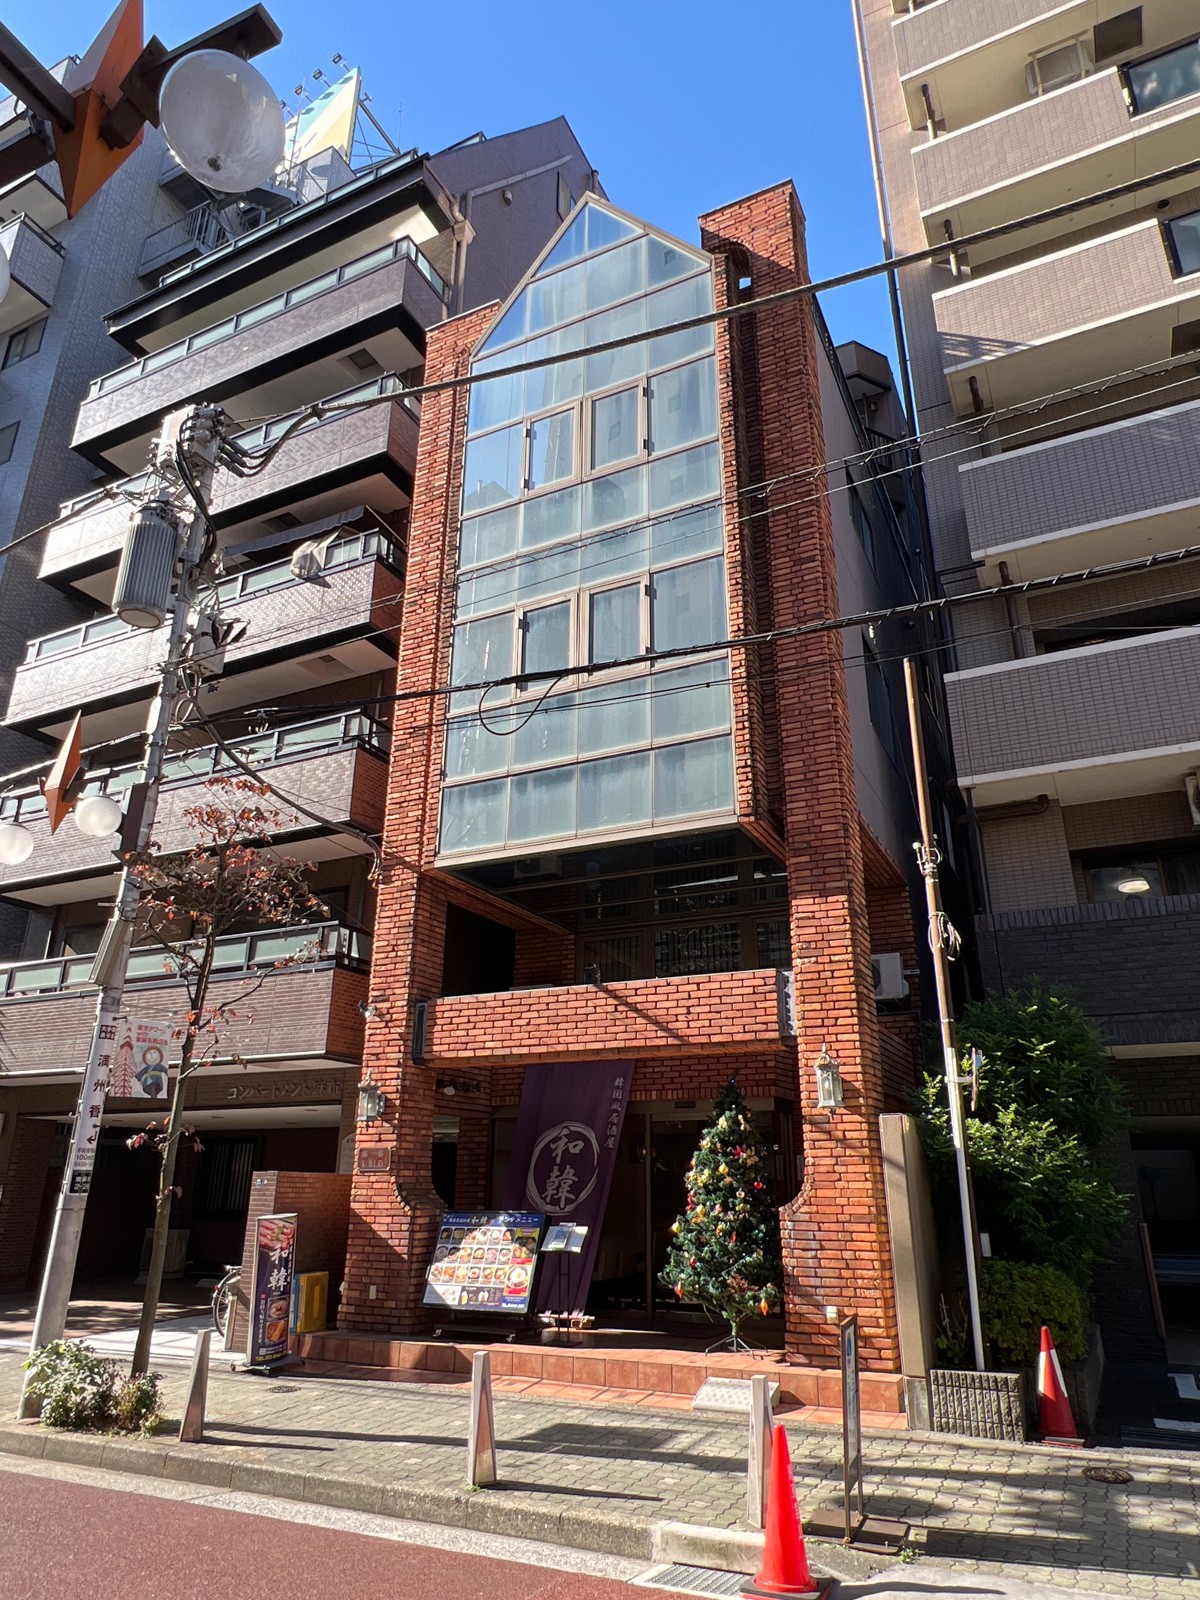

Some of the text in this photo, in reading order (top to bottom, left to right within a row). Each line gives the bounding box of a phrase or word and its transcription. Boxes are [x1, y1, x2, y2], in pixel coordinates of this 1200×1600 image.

[605, 1077, 625, 1149] 韓国風居酒屋
[541, 1126, 585, 1210] 和韓
[267, 1243, 289, 1291] 和韓
